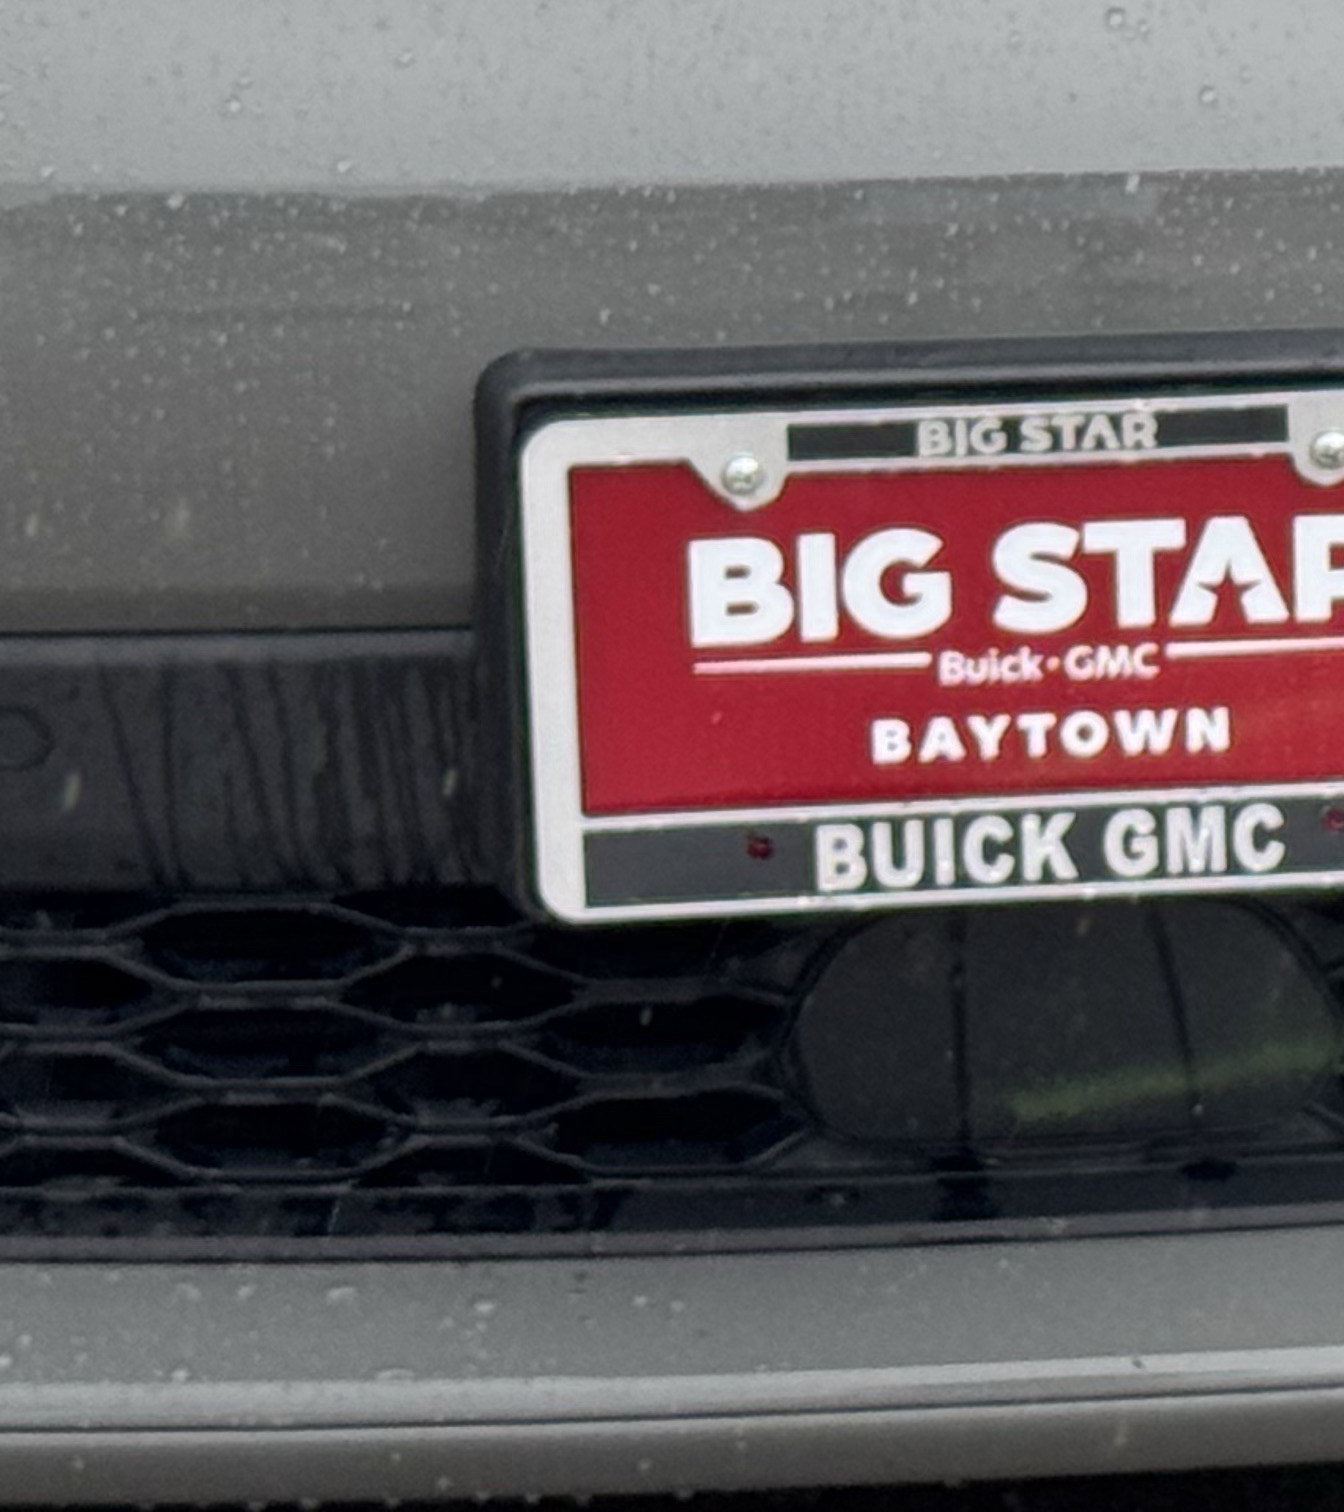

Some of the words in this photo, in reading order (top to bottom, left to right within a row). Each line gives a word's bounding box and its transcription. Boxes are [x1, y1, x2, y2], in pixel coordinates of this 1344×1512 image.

[916, 416, 1005, 459] BIG
[1019, 412, 1158, 453] STAR
[686, 526, 952, 648] BIG
[870, 706, 1231, 766] BAYTOWN
[814, 811, 1077, 893] BUICK
[1103, 802, 1286, 879] GMC
